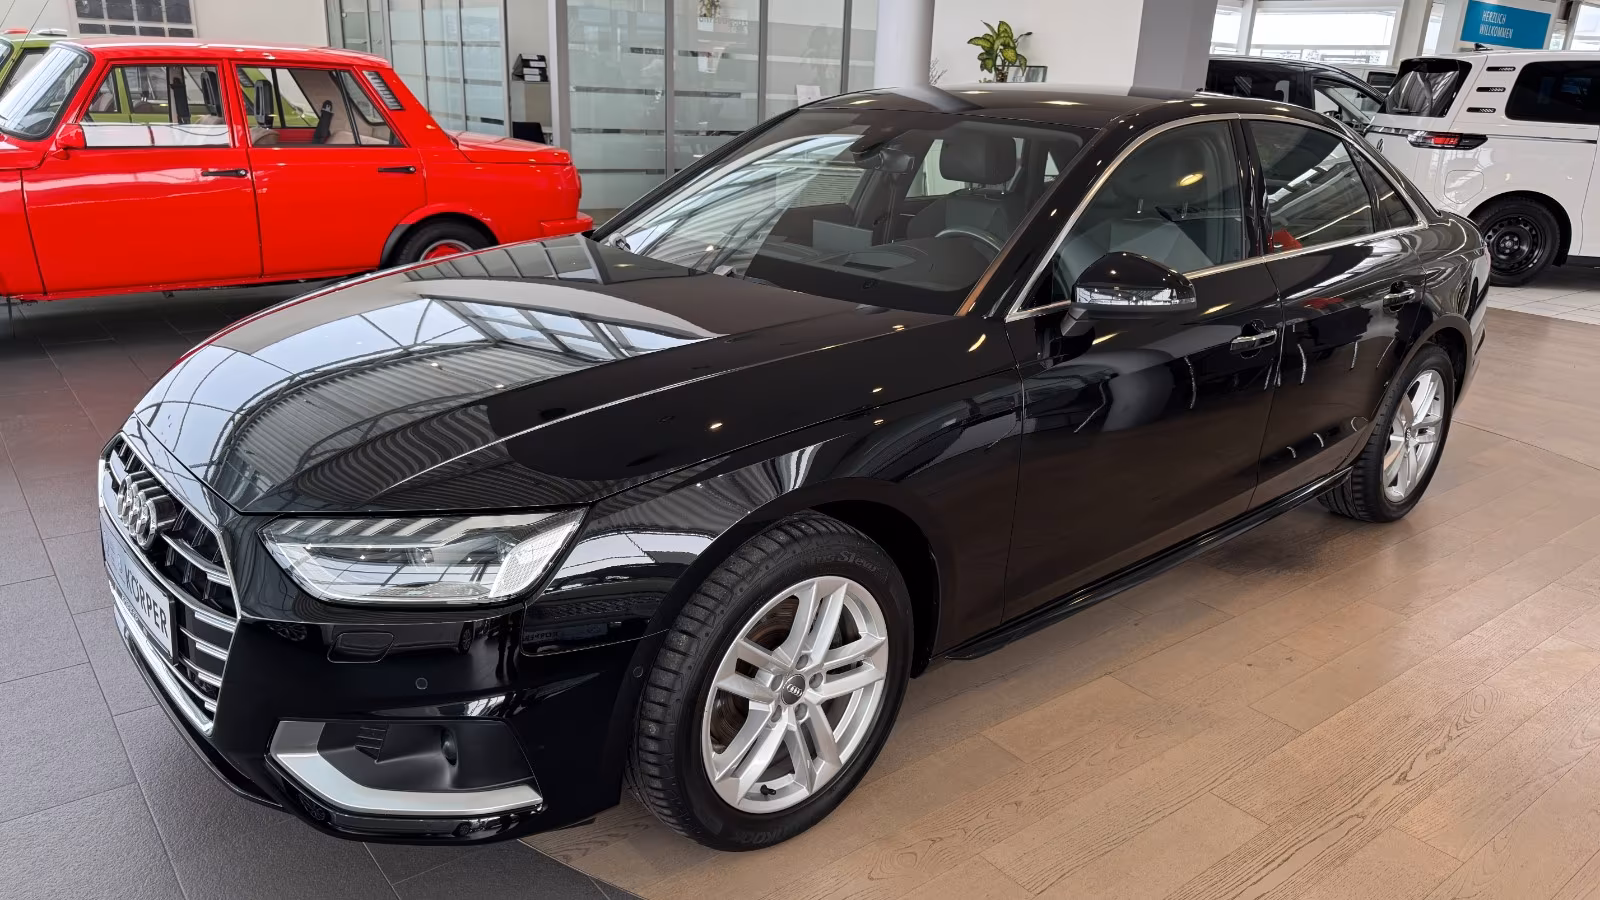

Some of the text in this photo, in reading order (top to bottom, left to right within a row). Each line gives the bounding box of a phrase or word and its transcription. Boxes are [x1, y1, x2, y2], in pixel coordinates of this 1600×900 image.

[1482, 10, 1506, 24] HERZLICH
[1479, 24, 1513, 38] WILLKOMMEN
[124, 564, 169, 639] KÖRPER
